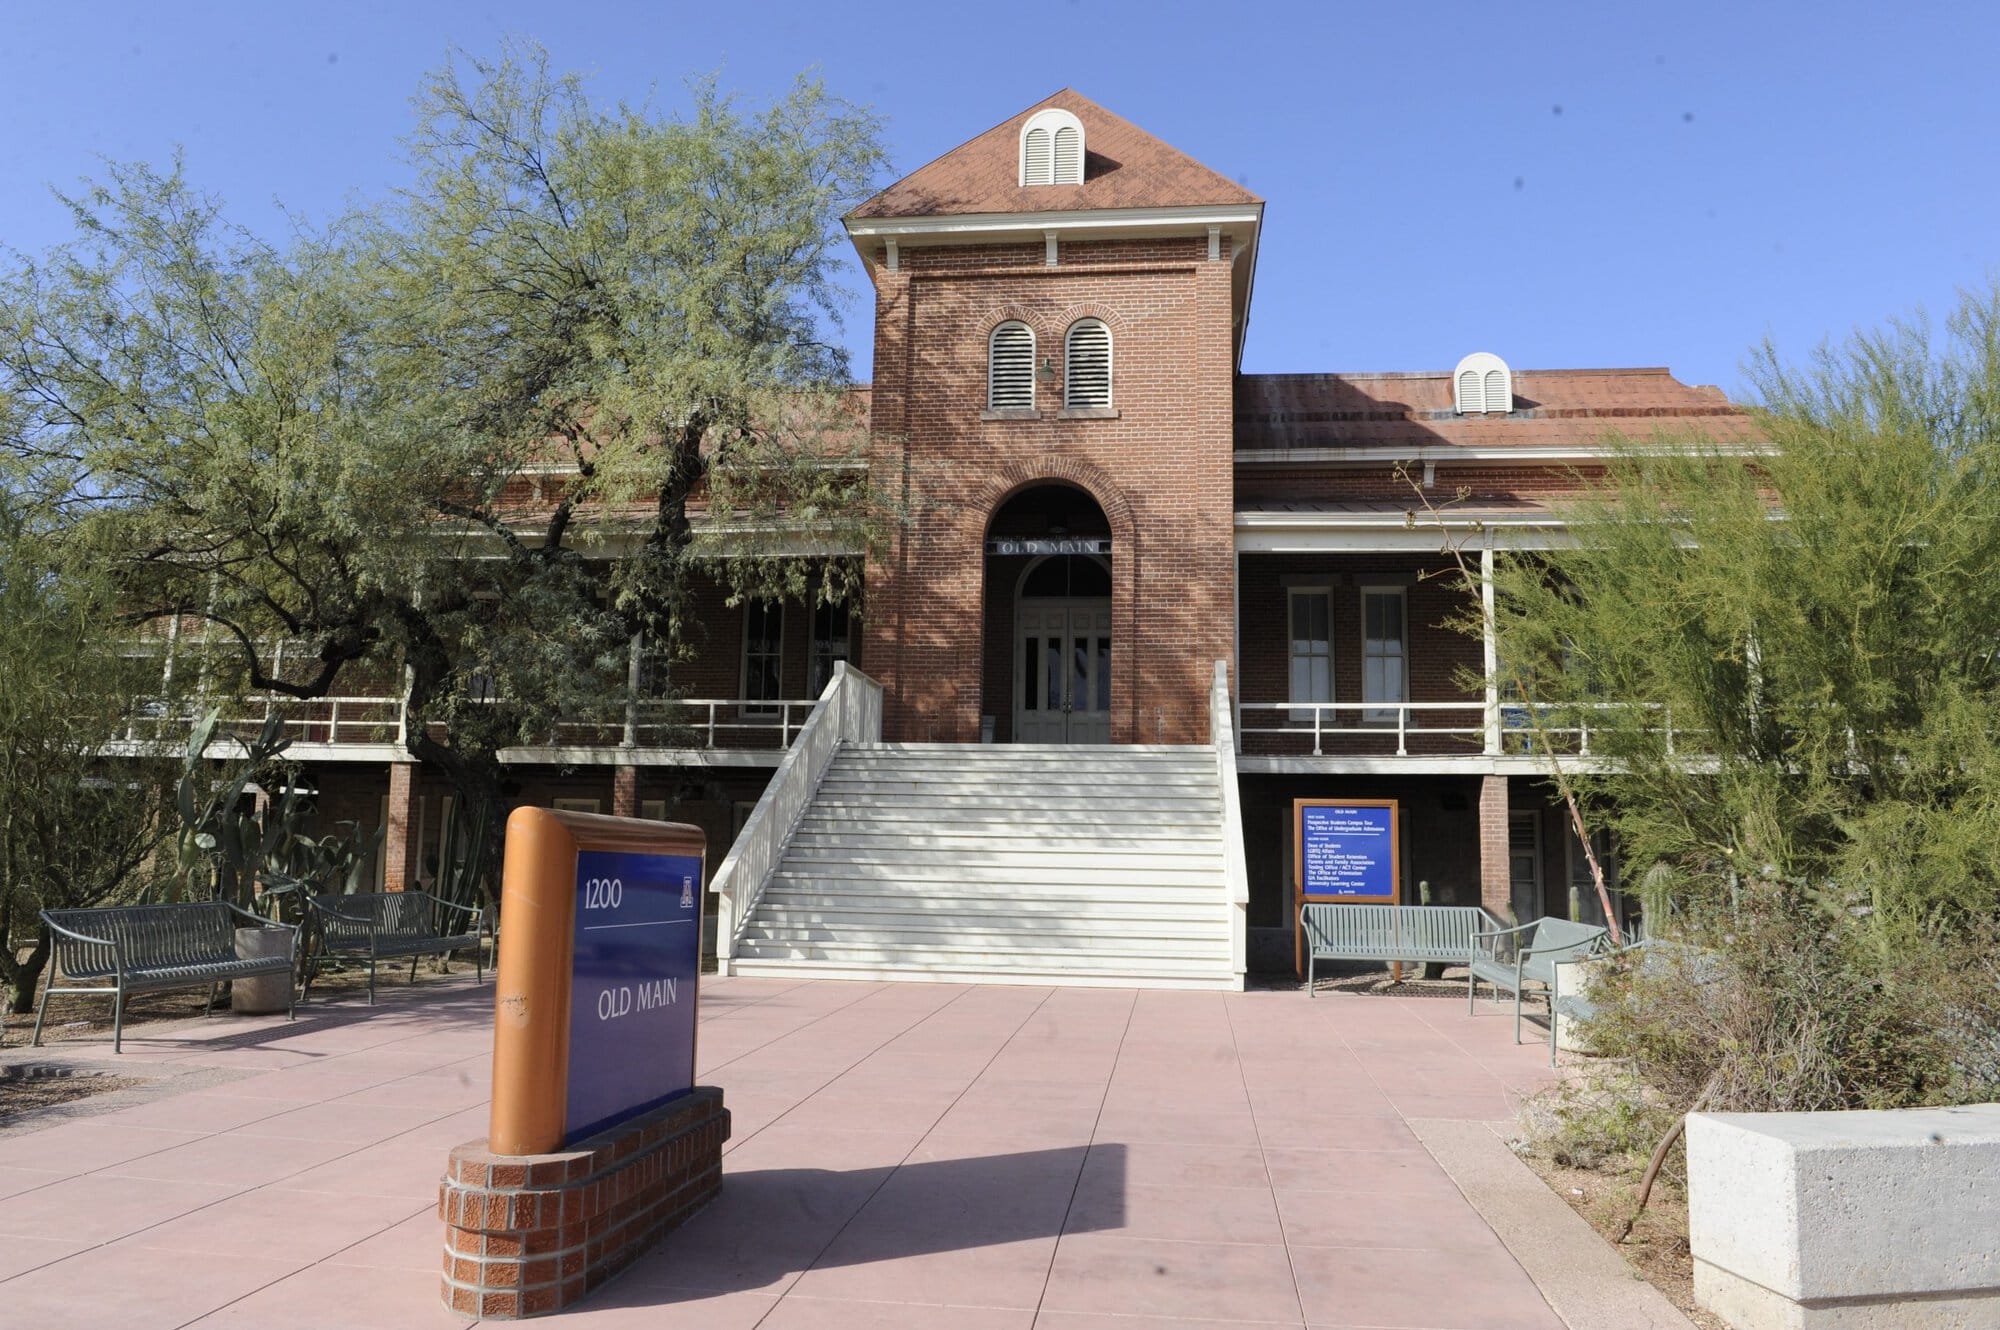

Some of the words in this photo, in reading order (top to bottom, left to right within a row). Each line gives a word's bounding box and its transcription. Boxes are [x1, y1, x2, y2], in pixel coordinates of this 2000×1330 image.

[1001, 542, 1038, 553] OLD
[1049, 542, 1094, 553] MAIN
[585, 878, 622, 909] 1200
[598, 986, 631, 1020] OLD
[636, 977, 678, 1012] MAIN
